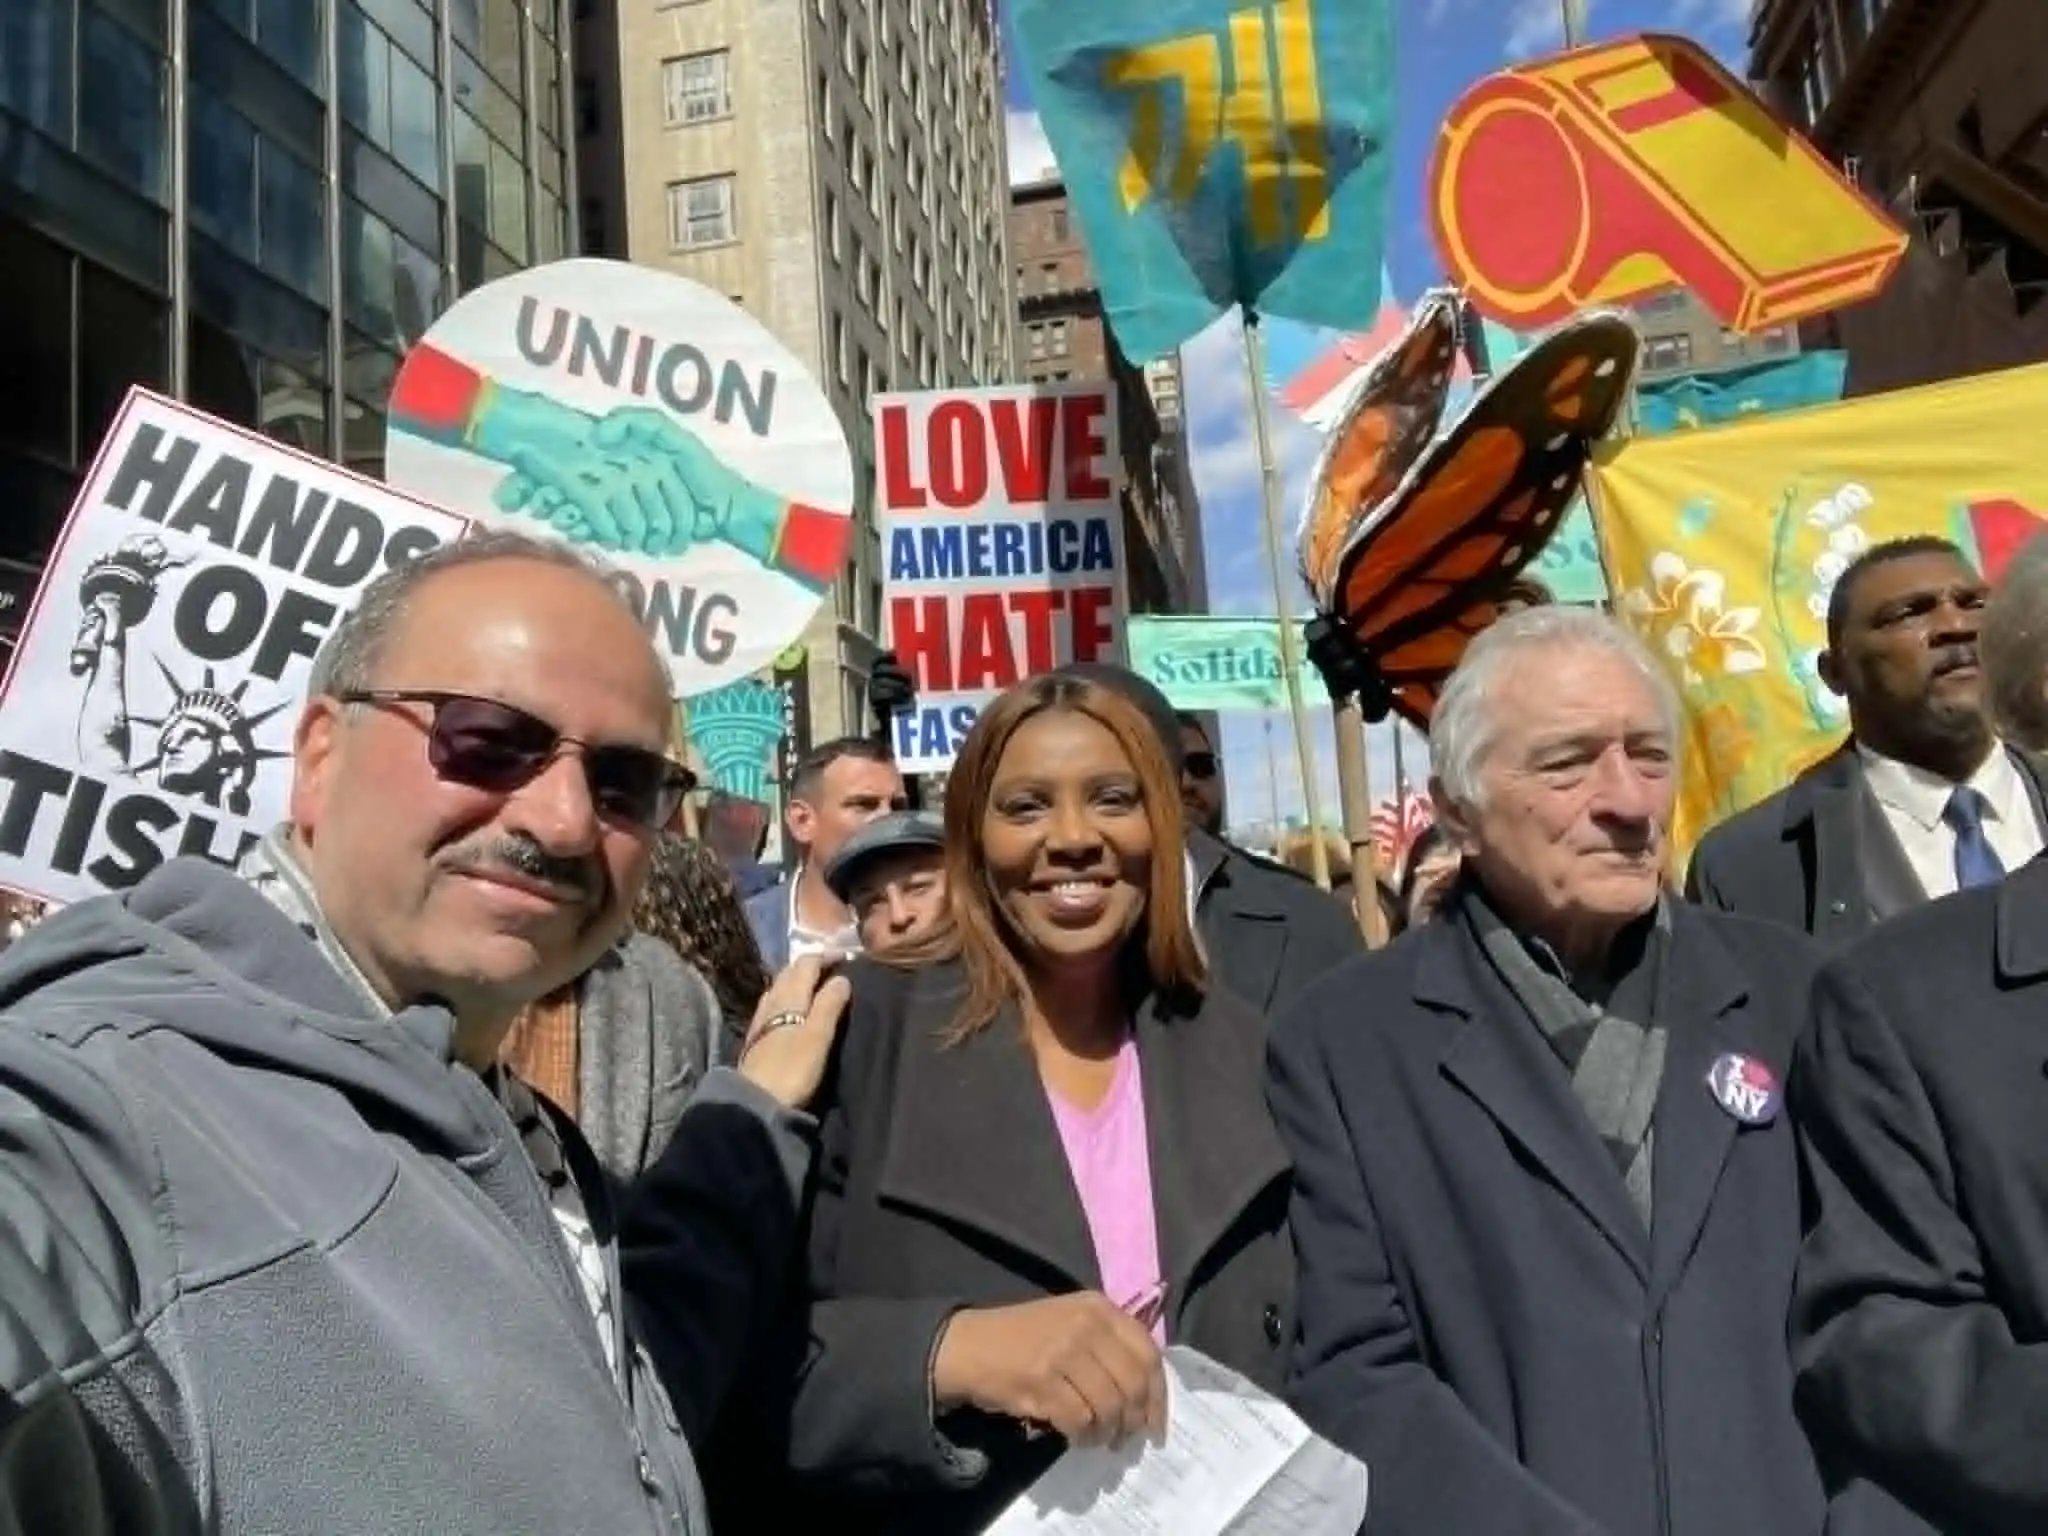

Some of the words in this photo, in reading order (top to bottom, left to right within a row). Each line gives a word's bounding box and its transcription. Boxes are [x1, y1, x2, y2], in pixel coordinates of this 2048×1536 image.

[514, 295, 777, 437] UNION
[881, 394, 1111, 510] LOVE
[890, 518, 1113, 580] AMERICA
[174, 563, 345, 682] OF
[890, 586, 1114, 693] HATE
[1724, 1081, 1769, 1118] NY
